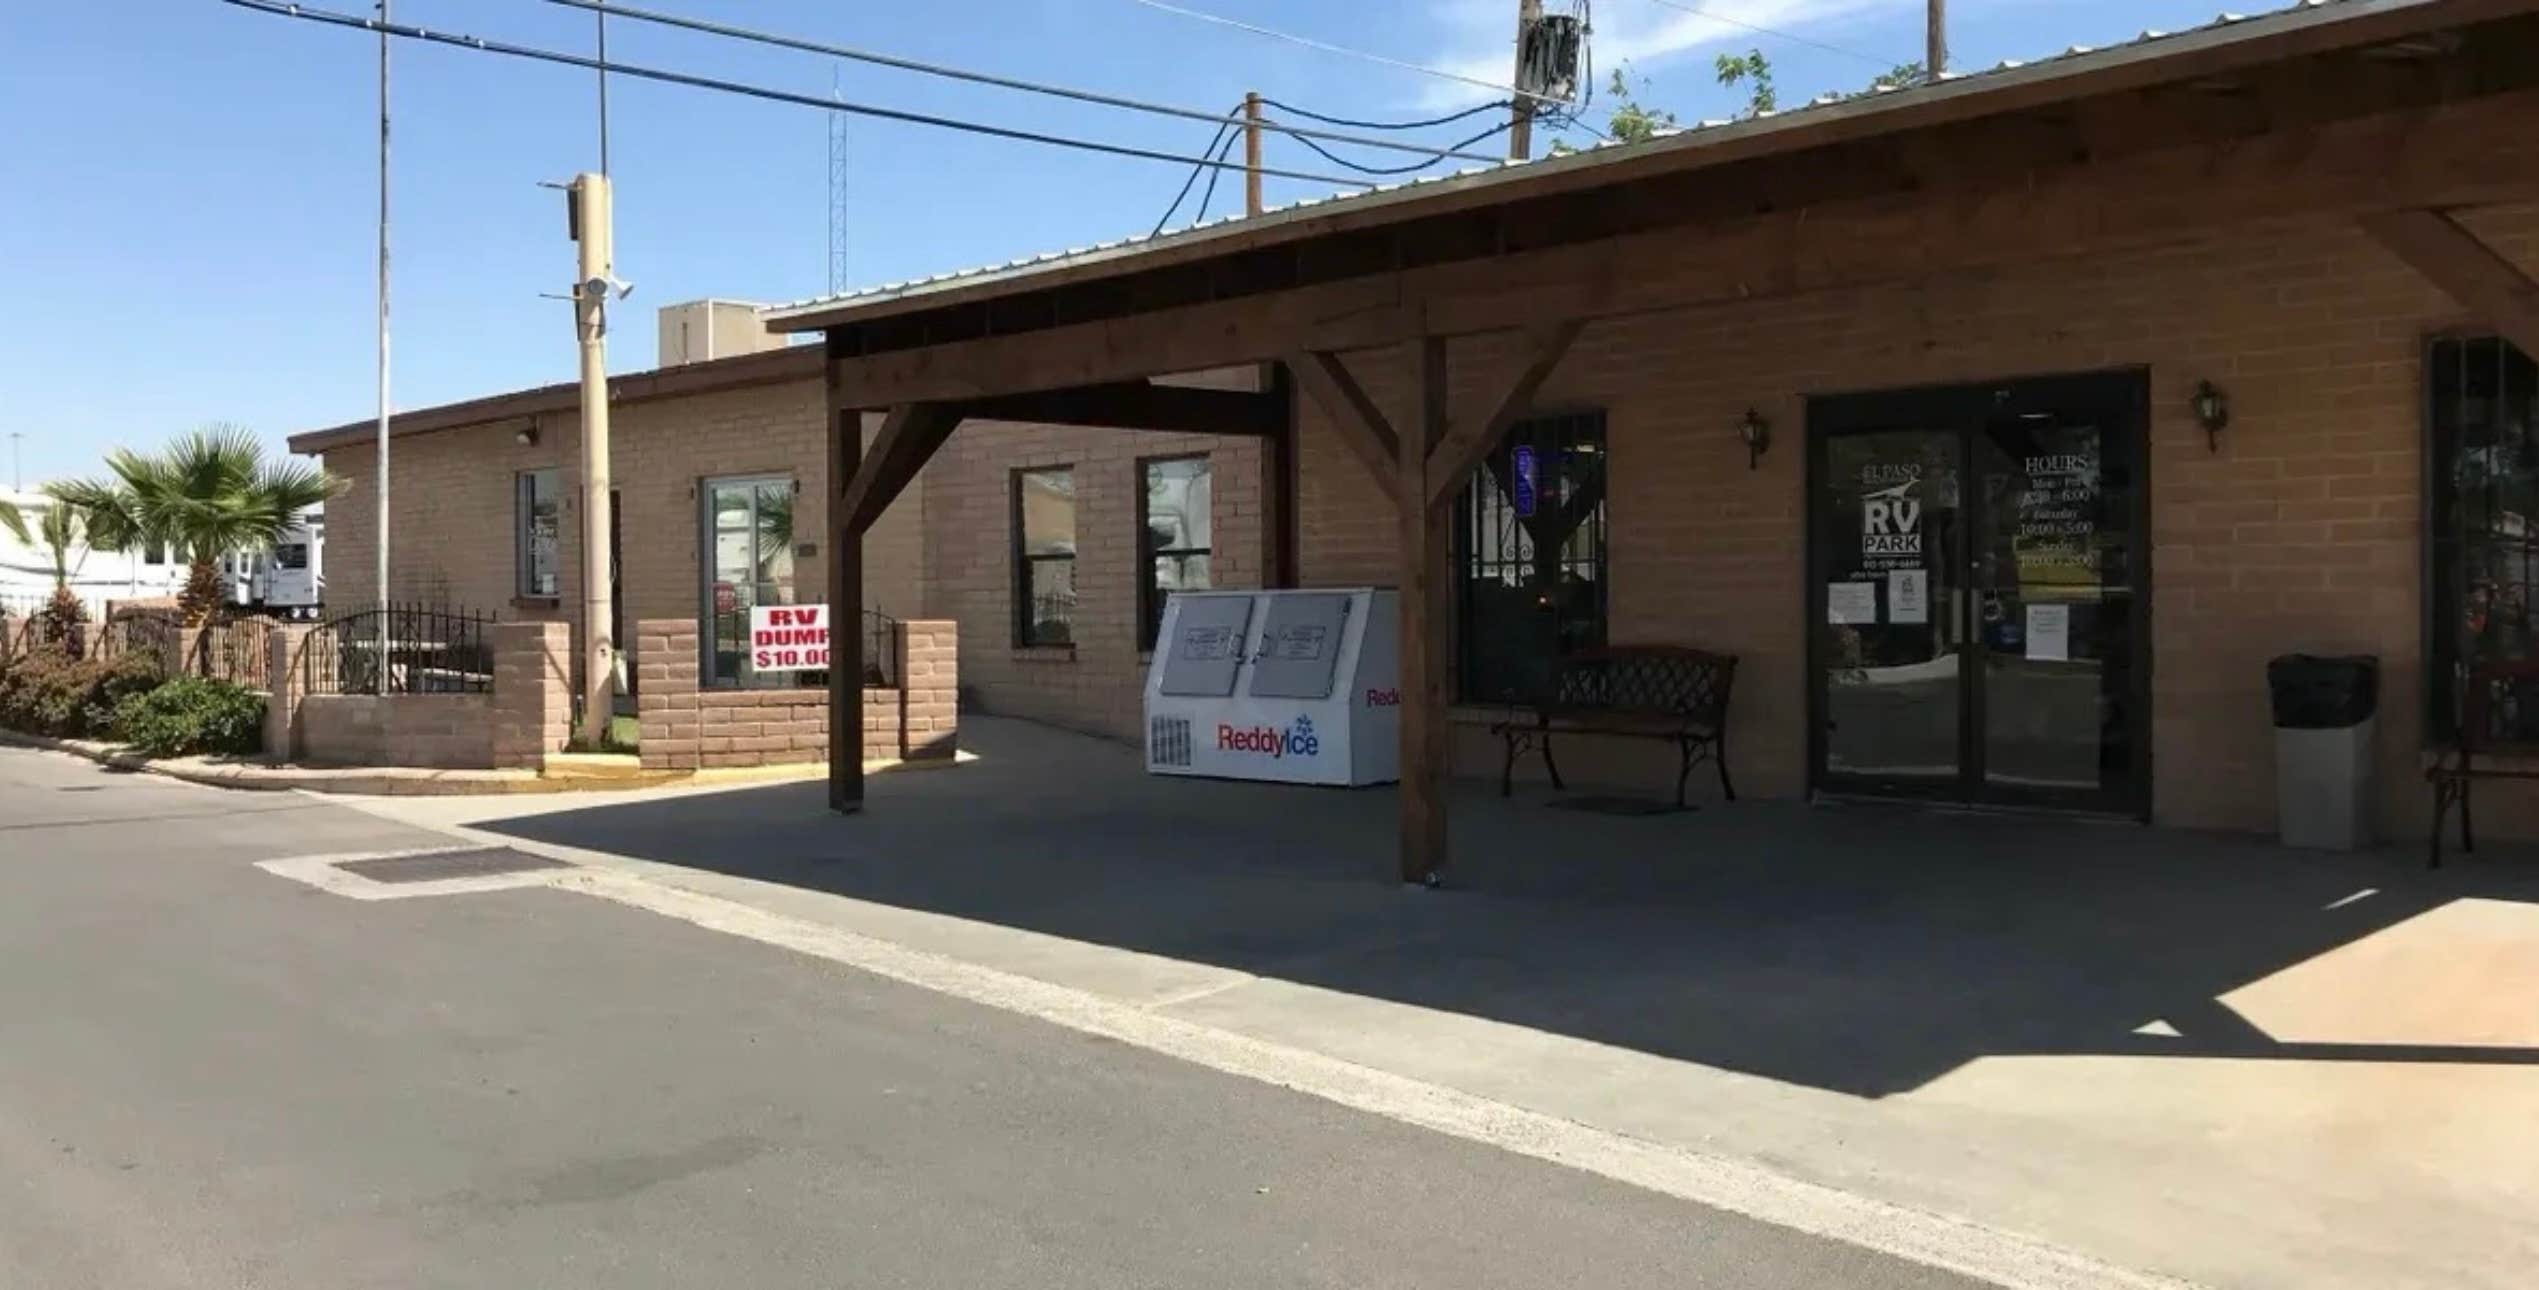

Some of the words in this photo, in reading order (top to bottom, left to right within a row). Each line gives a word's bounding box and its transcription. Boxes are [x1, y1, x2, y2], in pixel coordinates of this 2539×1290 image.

[1882, 463, 1921, 477] PASO
[2025, 454, 2088, 473] HOURS
[1864, 501, 1920, 534] RV
[1865, 536, 1918, 551] PARK
[769, 609, 818, 626] RV
